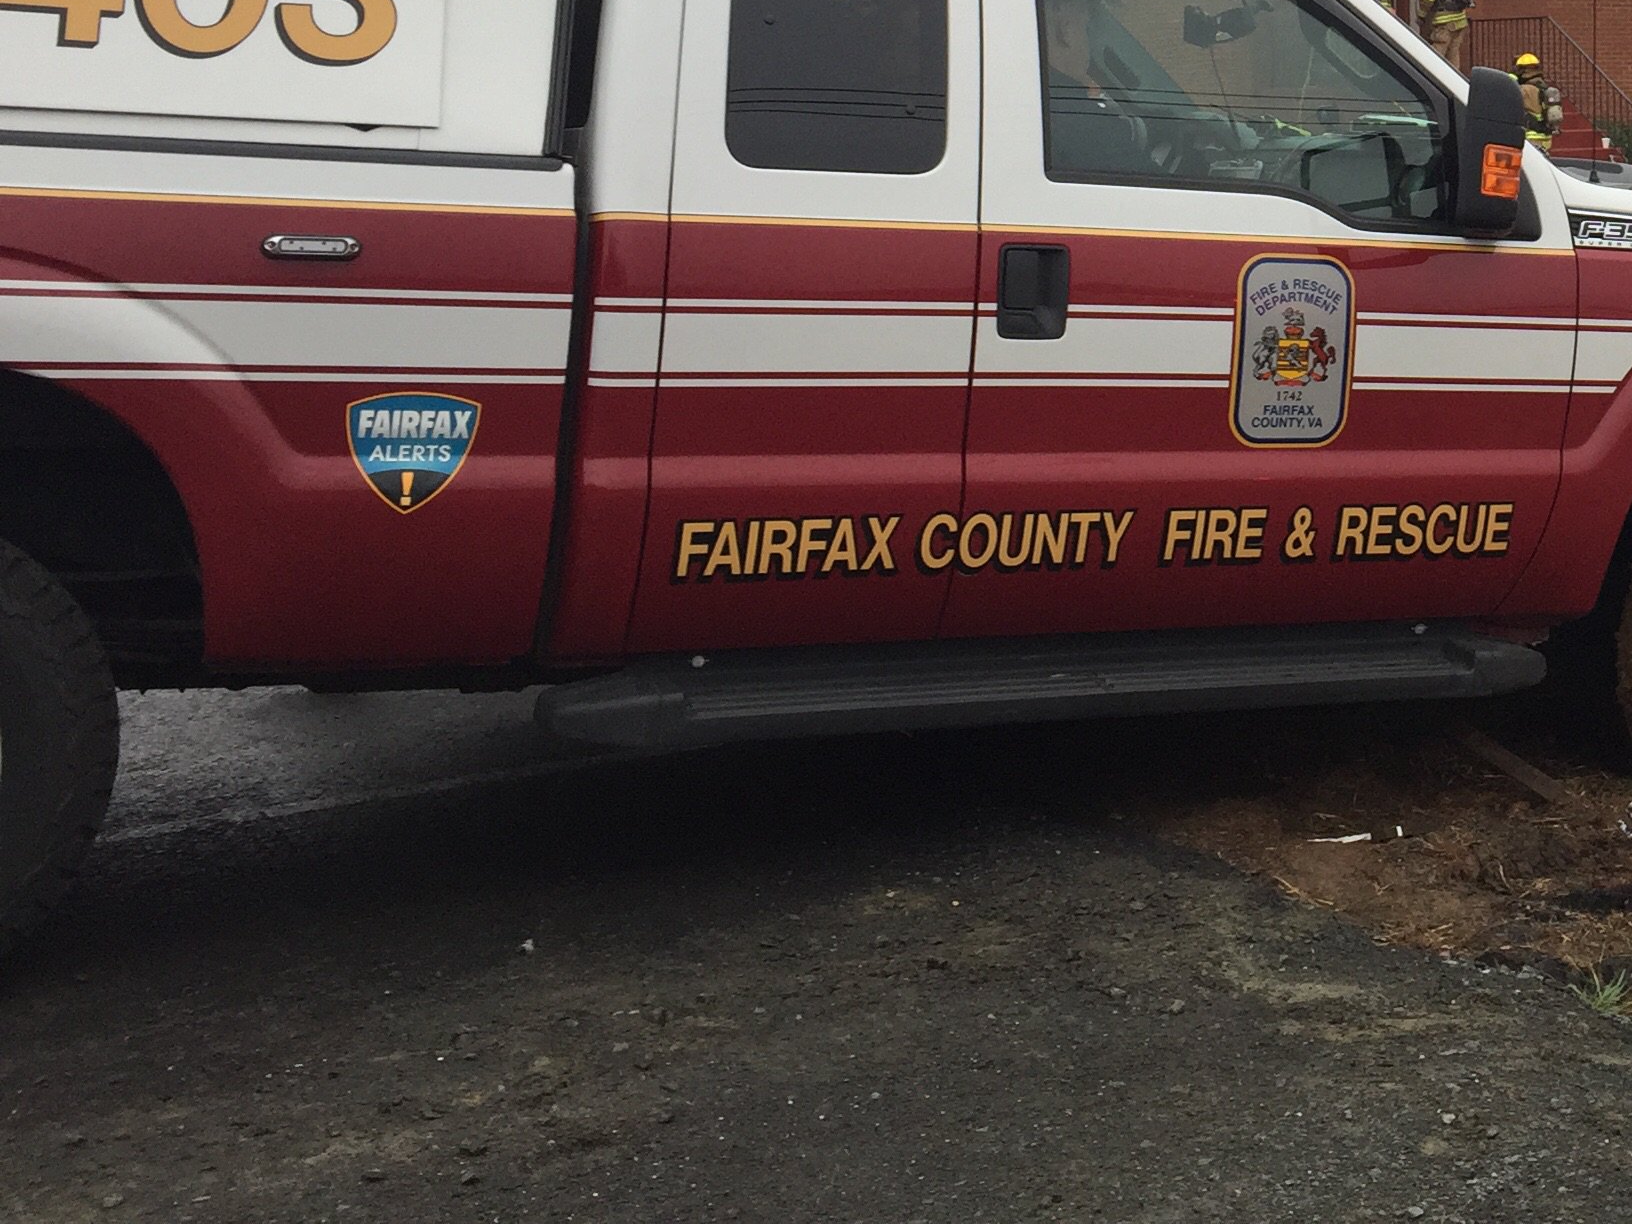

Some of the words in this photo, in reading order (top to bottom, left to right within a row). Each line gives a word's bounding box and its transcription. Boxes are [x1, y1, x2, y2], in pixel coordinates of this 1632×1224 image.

[1250, 283, 1278, 305] FIRE
[1281, 280, 1290, 290] &
[1293, 279, 1343, 305] RESCUE
[1255, 291, 1338, 317] DEPARTMENT
[1276, 390, 1303, 401] 1742
[1263, 405, 1314, 416] FAIRFAX
[358, 410, 472, 439] FAIRFAX
[1251, 417, 1305, 429] COUNTY,
[1307, 417, 1323, 428] VA
[368, 445, 451, 462] ALERTS
[676, 516, 900, 577] FAIRFAX
[920, 511, 1135, 569] COUNTY
[1163, 508, 1268, 560] FIRE
[1285, 507, 1316, 558] &
[1335, 503, 1514, 557] RESCUE
